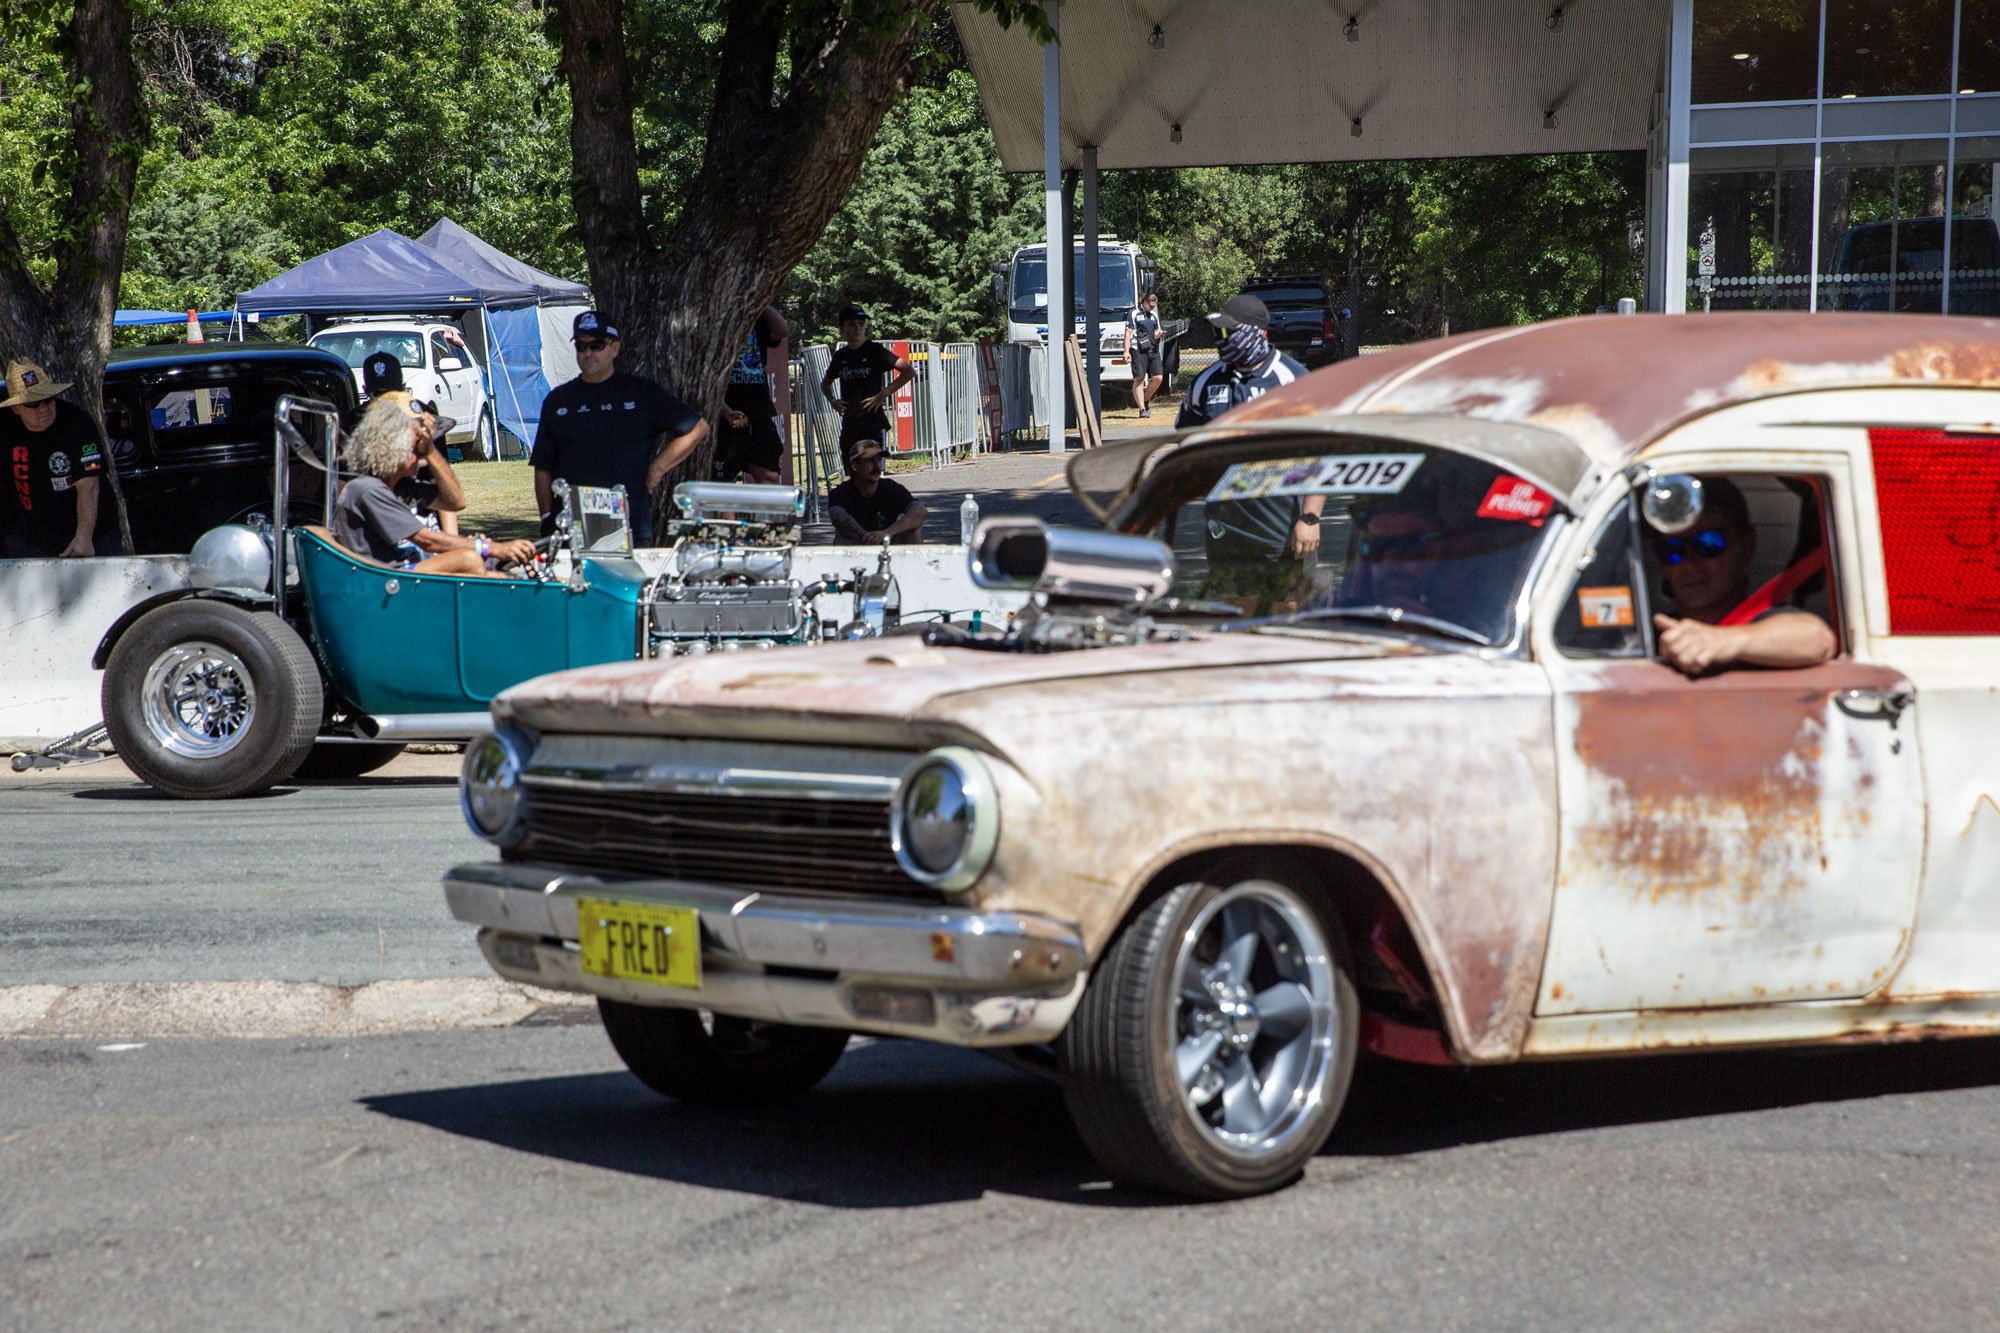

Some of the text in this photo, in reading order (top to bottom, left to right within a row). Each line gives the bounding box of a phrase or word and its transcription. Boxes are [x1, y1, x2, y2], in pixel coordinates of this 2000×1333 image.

[1321, 461, 1406, 487] 2019
[1601, 604, 1612, 621] 7
[605, 918, 670, 976] FRED
